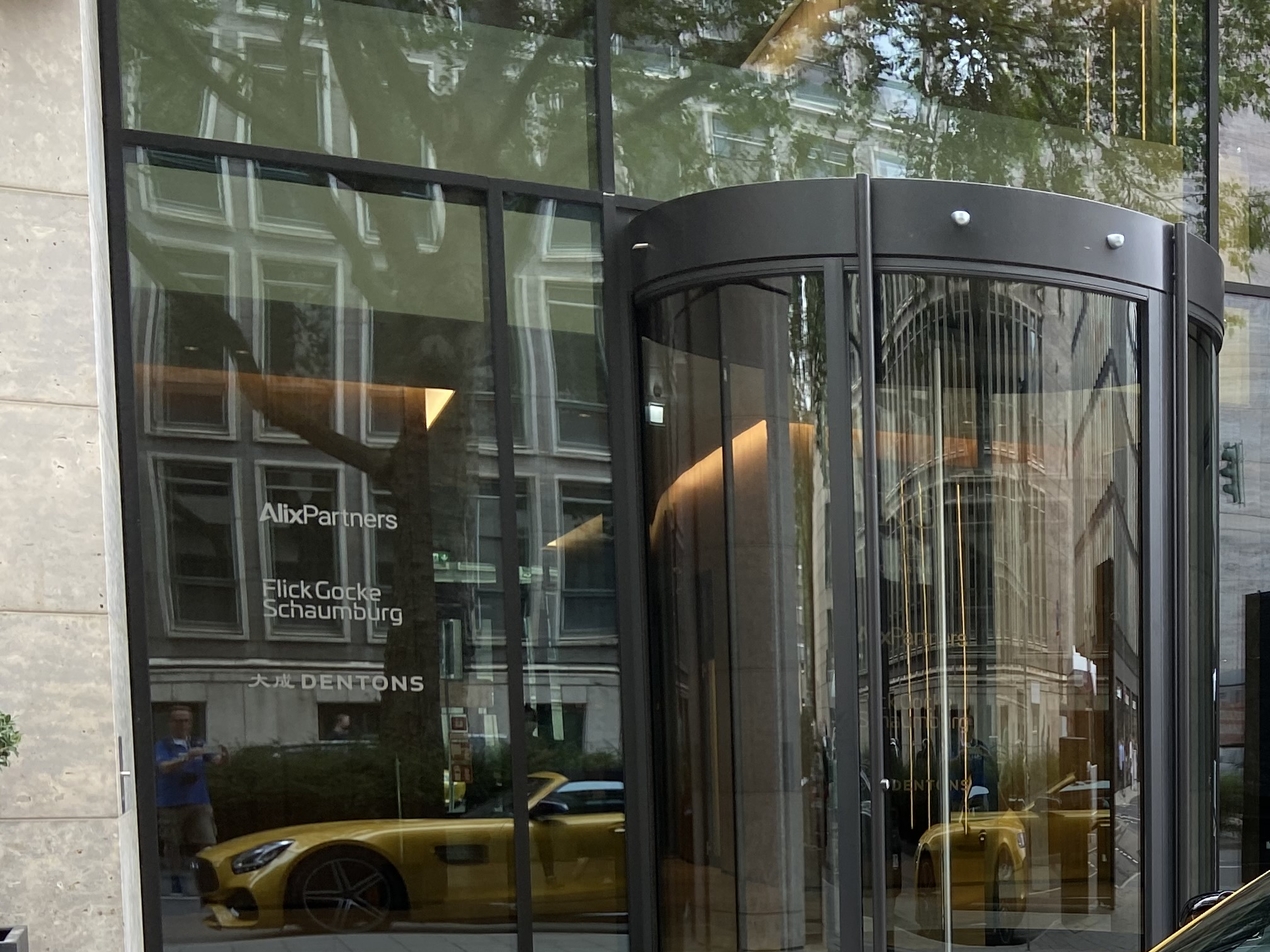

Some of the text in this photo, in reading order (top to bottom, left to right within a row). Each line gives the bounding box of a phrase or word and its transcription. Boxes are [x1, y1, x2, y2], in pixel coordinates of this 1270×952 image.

[259, 502, 398, 530] AlixPartners
[263, 578, 382, 602] Flick Gocke
[263, 599, 403, 627] Schaumburg
[301, 673, 424, 692] DENTONS
